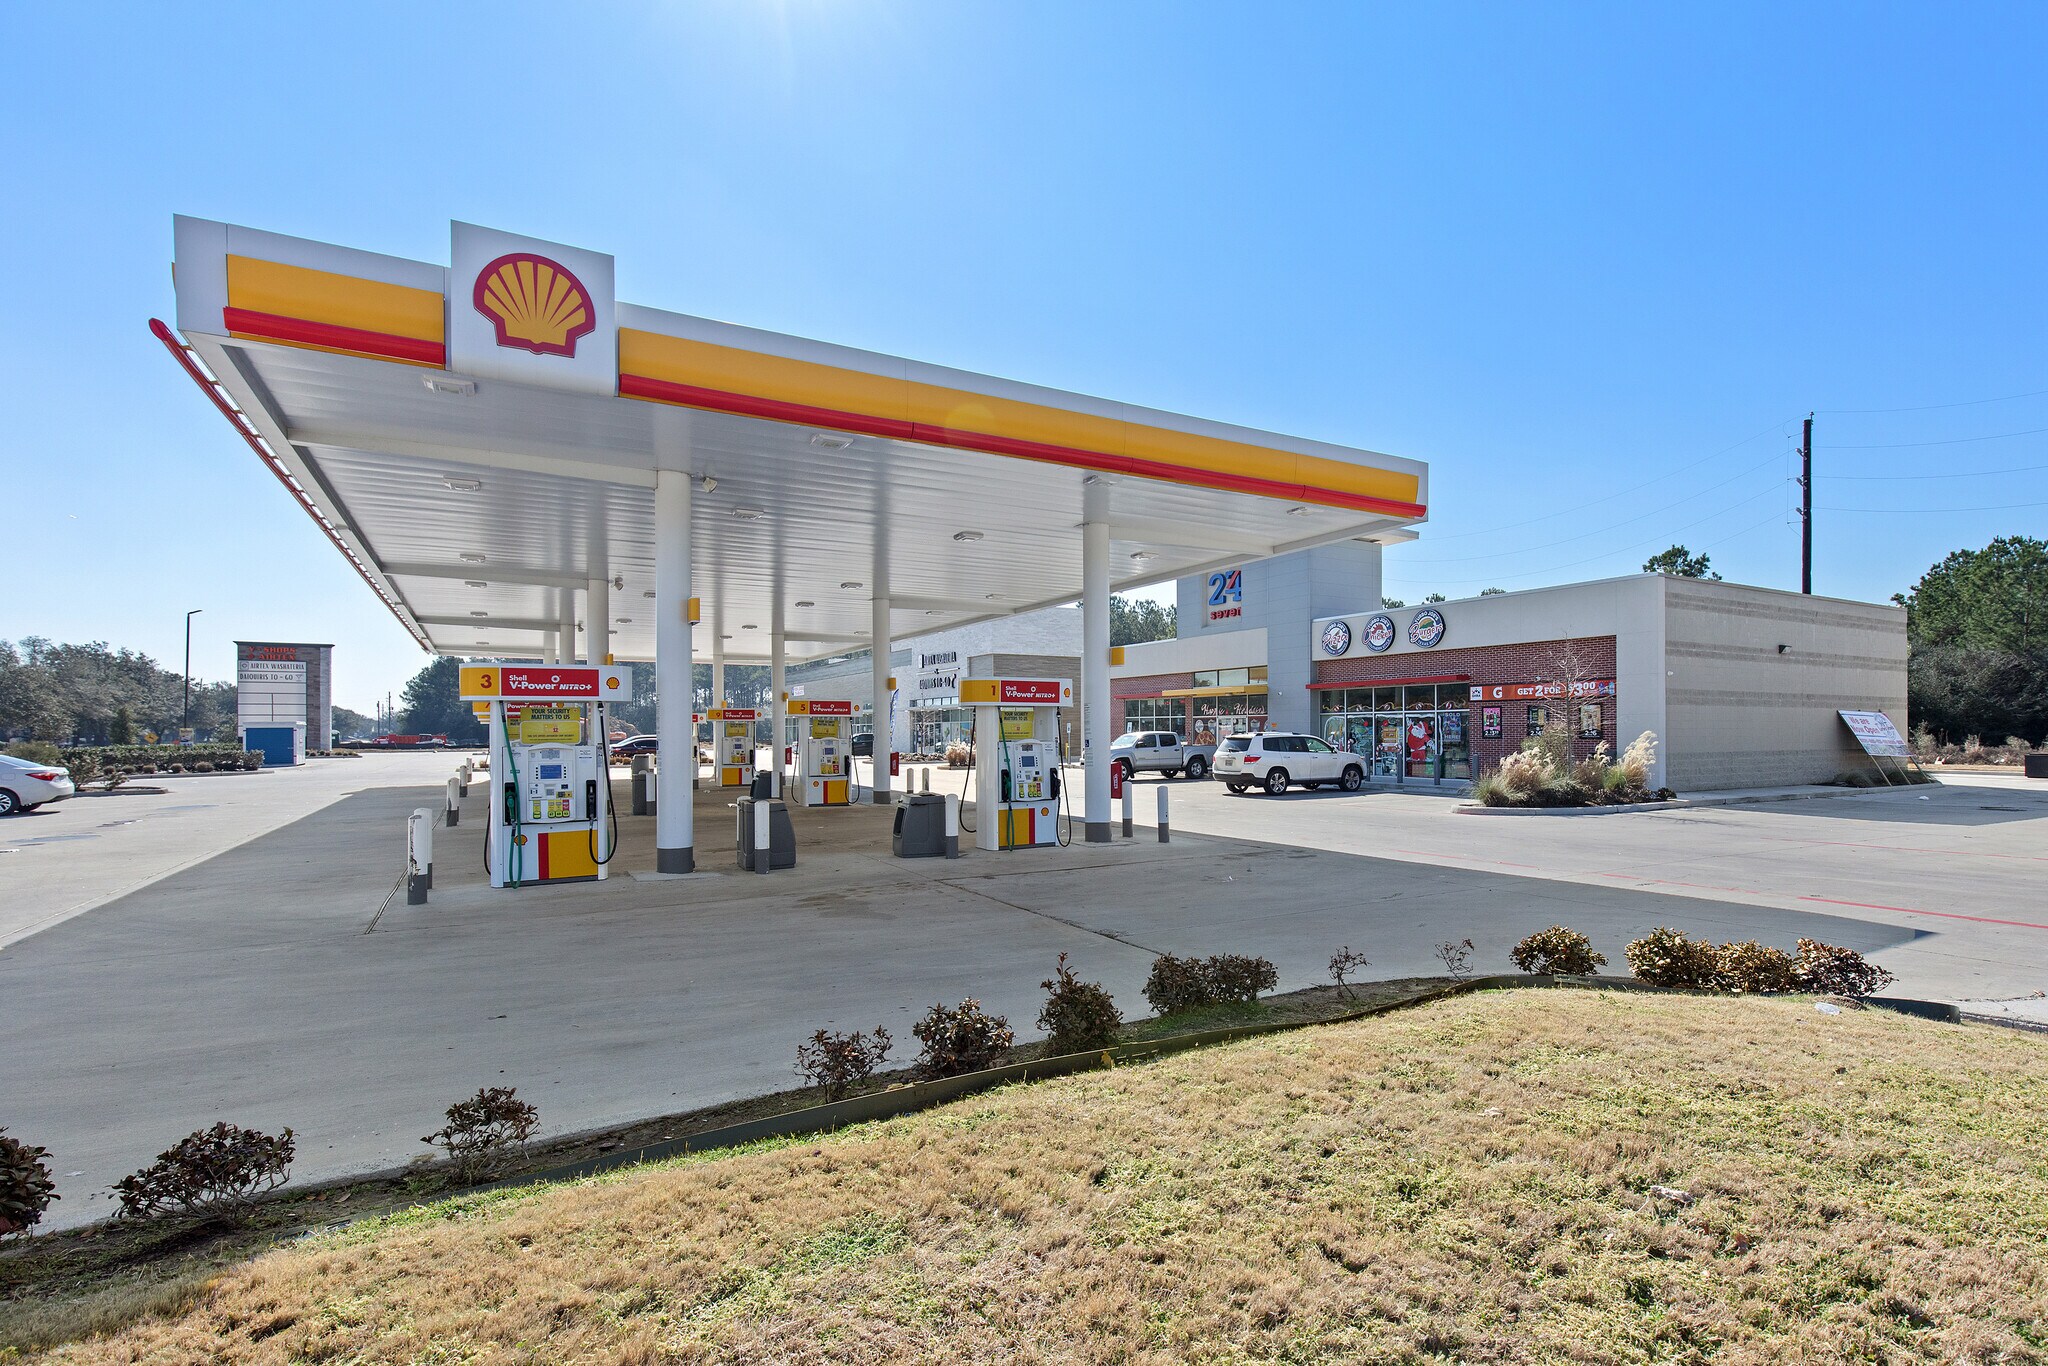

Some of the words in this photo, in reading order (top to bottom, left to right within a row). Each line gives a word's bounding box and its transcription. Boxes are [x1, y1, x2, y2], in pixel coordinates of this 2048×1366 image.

[1208, 570, 1242, 605] 24
[1409, 623, 1444, 643] Burgers
[480, 673, 492, 689] 3
[509, 682, 556, 690] V-Power
[991, 685, 996, 696] 1
[1492, 686, 1503, 699] G
[1517, 687, 1533, 695] GET
[1535, 685, 1544, 697] 2
[1544, 686, 1561, 694] FOR
[800, 703, 806, 712] 5
[1863, 725, 1880, 735] Open
